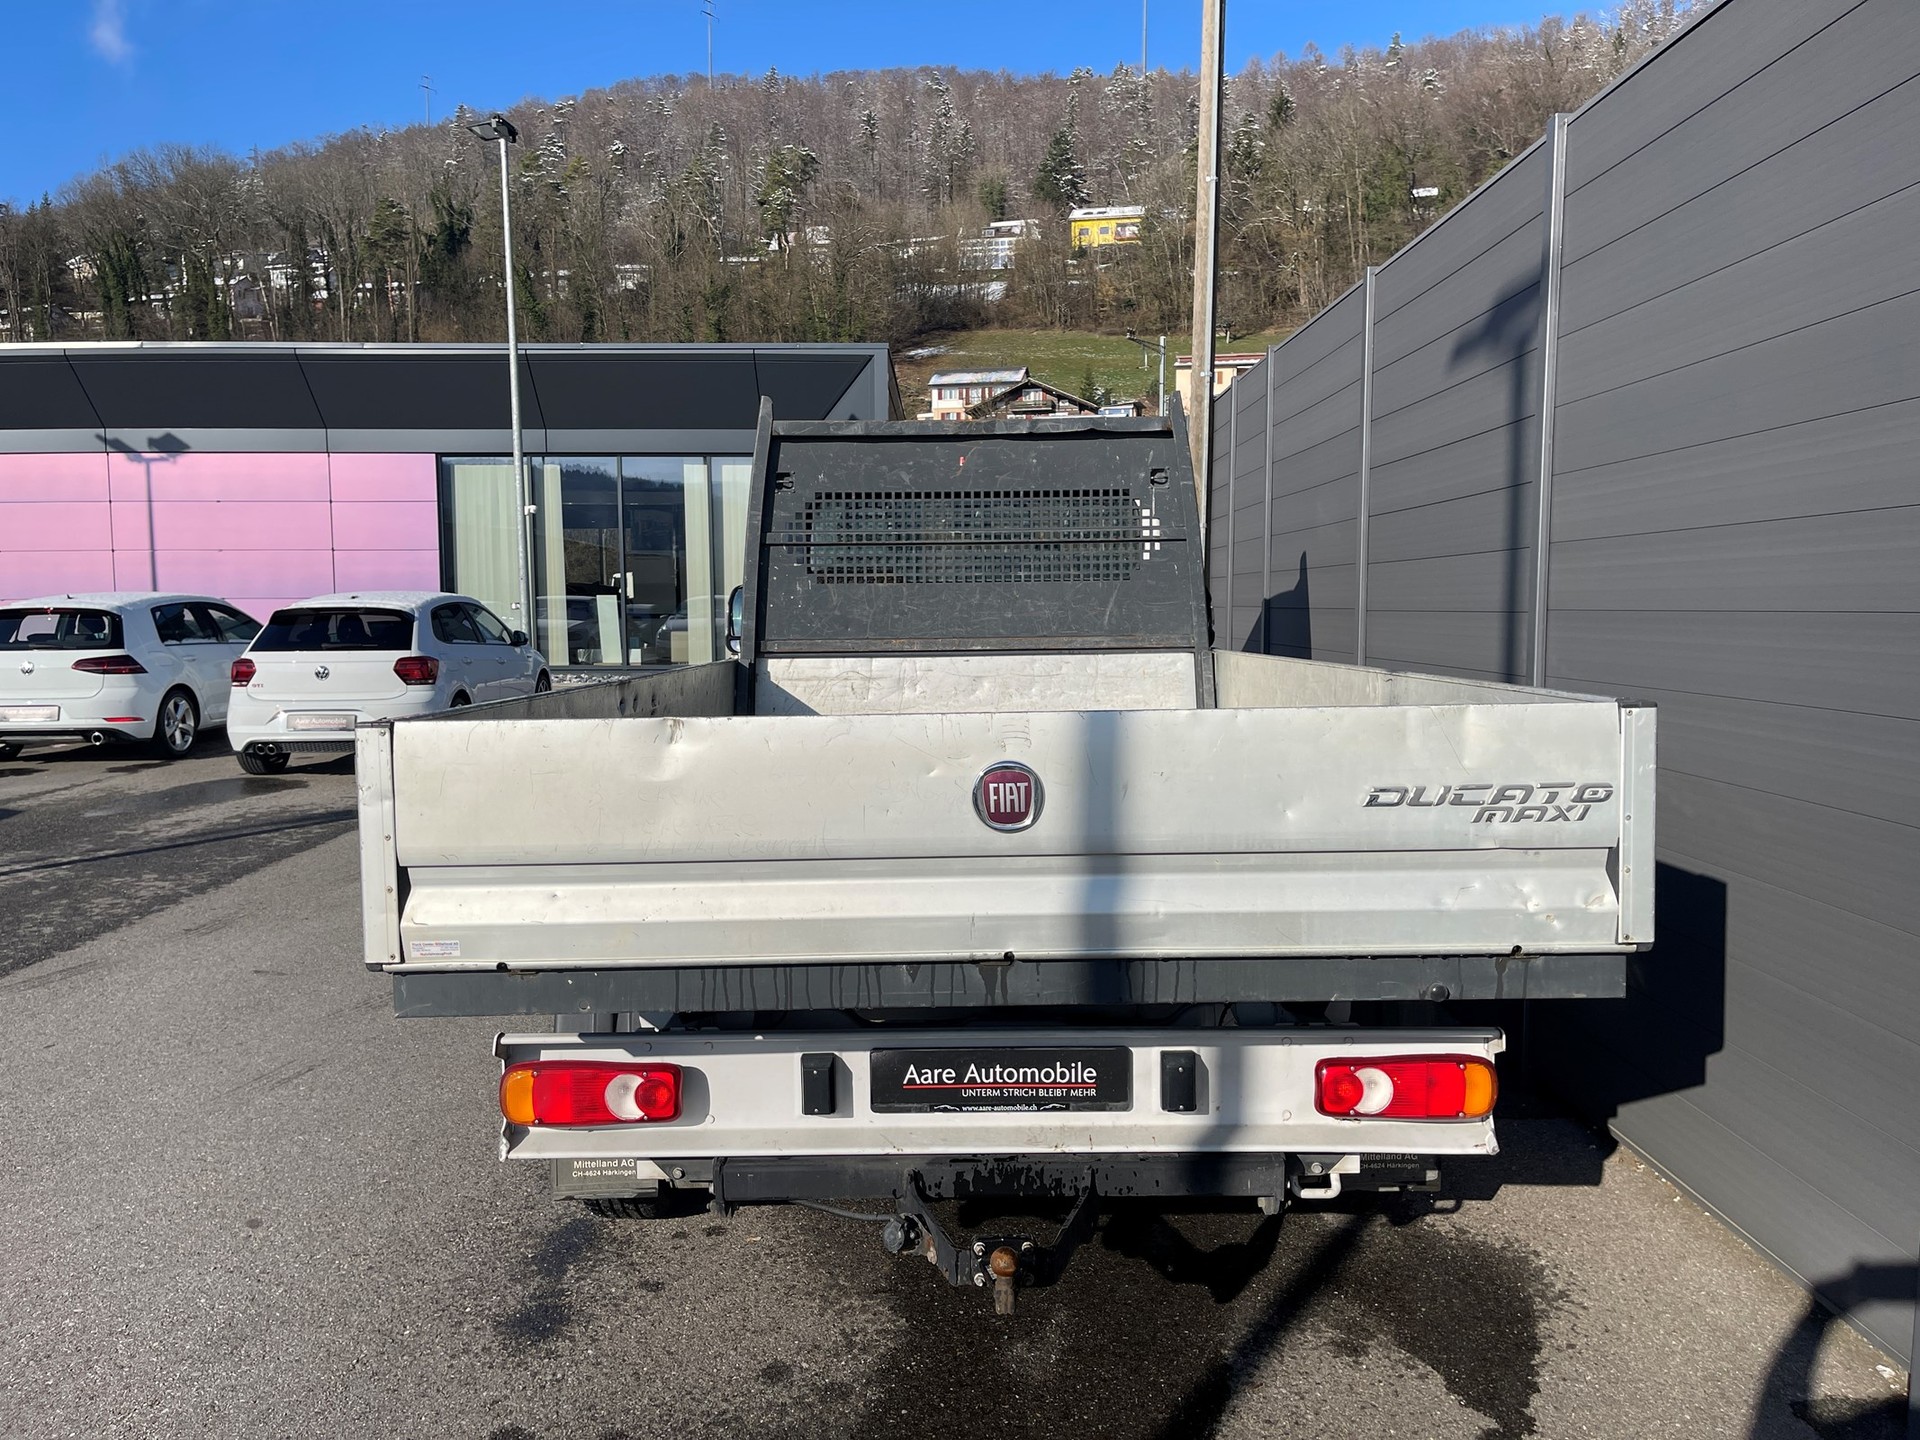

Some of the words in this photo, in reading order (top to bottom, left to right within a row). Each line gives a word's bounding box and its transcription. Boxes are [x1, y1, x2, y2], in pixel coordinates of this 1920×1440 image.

[989, 782, 1029, 813] FIAT
[1363, 782, 1614, 807] DUCATO
[1470, 804, 1592, 823] MAXI
[903, 1063, 956, 1084] Aare
[963, 1061, 1097, 1083] Automobile
[962, 1088, 1000, 1097] UNTERM
[1003, 1088, 1036, 1097] STRICH
[1038, 1088, 1067, 1097] BLEIBT
[1070, 1088, 1096, 1097] MEHR
[962, 1103, 1038, 1111] www.aare-automobile.ch
[573, 1160, 618, 1169] Mittelland
[620, 1159, 635, 1167] AG
[1361, 1153, 1402, 1161] Mittelland
